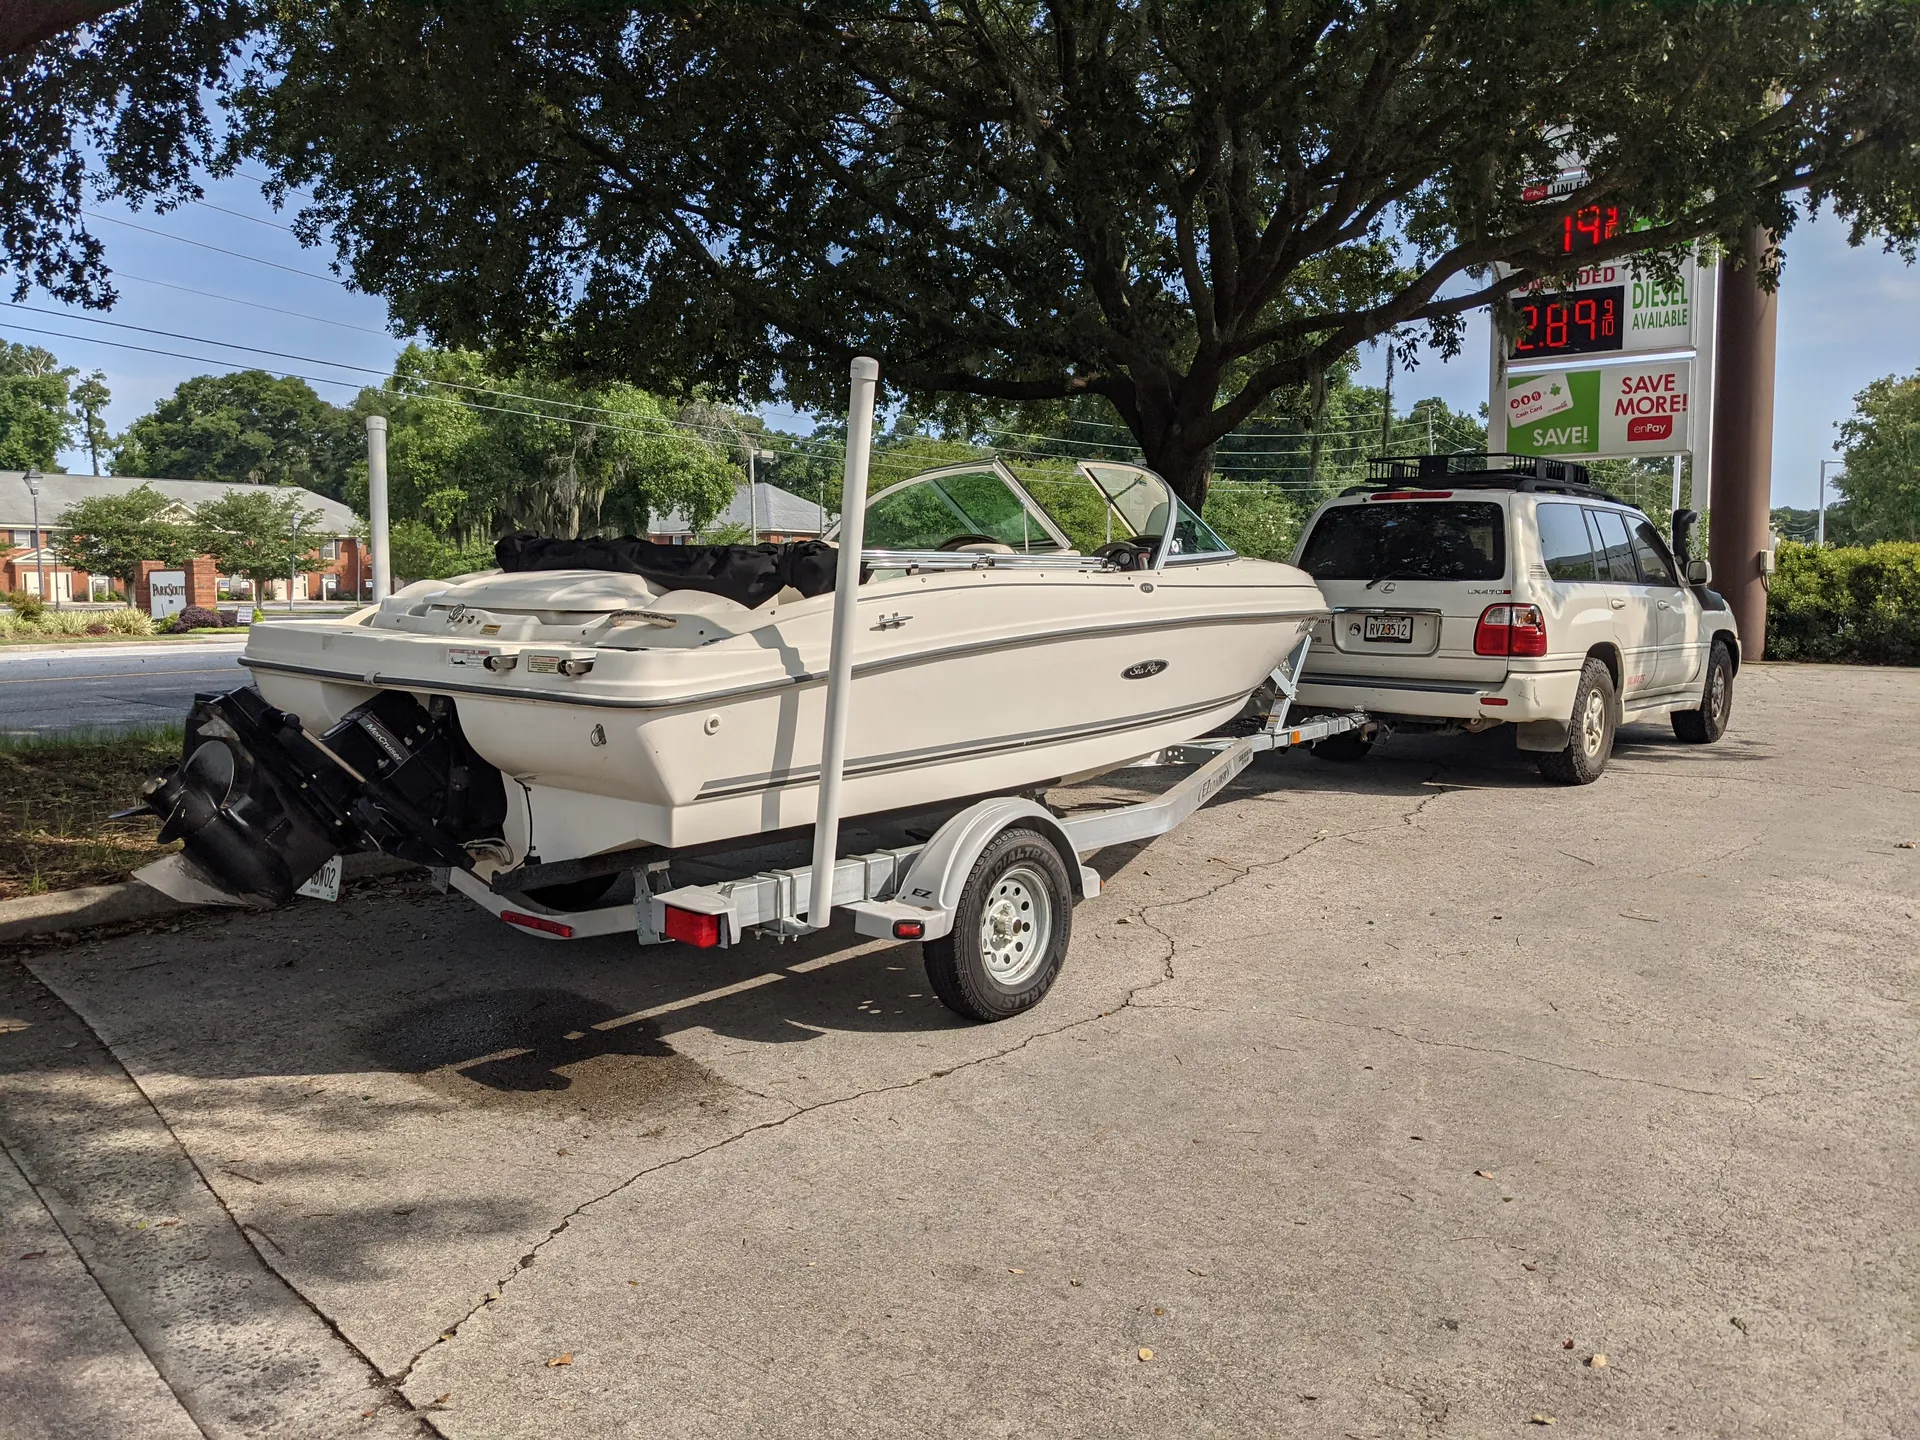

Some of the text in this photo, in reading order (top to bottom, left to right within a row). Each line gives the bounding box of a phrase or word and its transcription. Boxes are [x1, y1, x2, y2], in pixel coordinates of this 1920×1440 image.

[1632, 276, 1688, 309] DIESEL
[1632, 309, 1688, 330] AVAILABLE
[1621, 373, 1676, 395] SAVE
[1515, 410, 1530, 419] Cash
[1529, 405, 1543, 414] Card
[1614, 393, 1688, 417] MORE!
[1532, 425, 1588, 447] SAVE!
[1633, 421, 1667, 435] enPay
[1129, 661, 1161, 676] Sea Ray
[365, 723, 403, 761] MerCruiser
[910, 887, 934, 900] EZ
